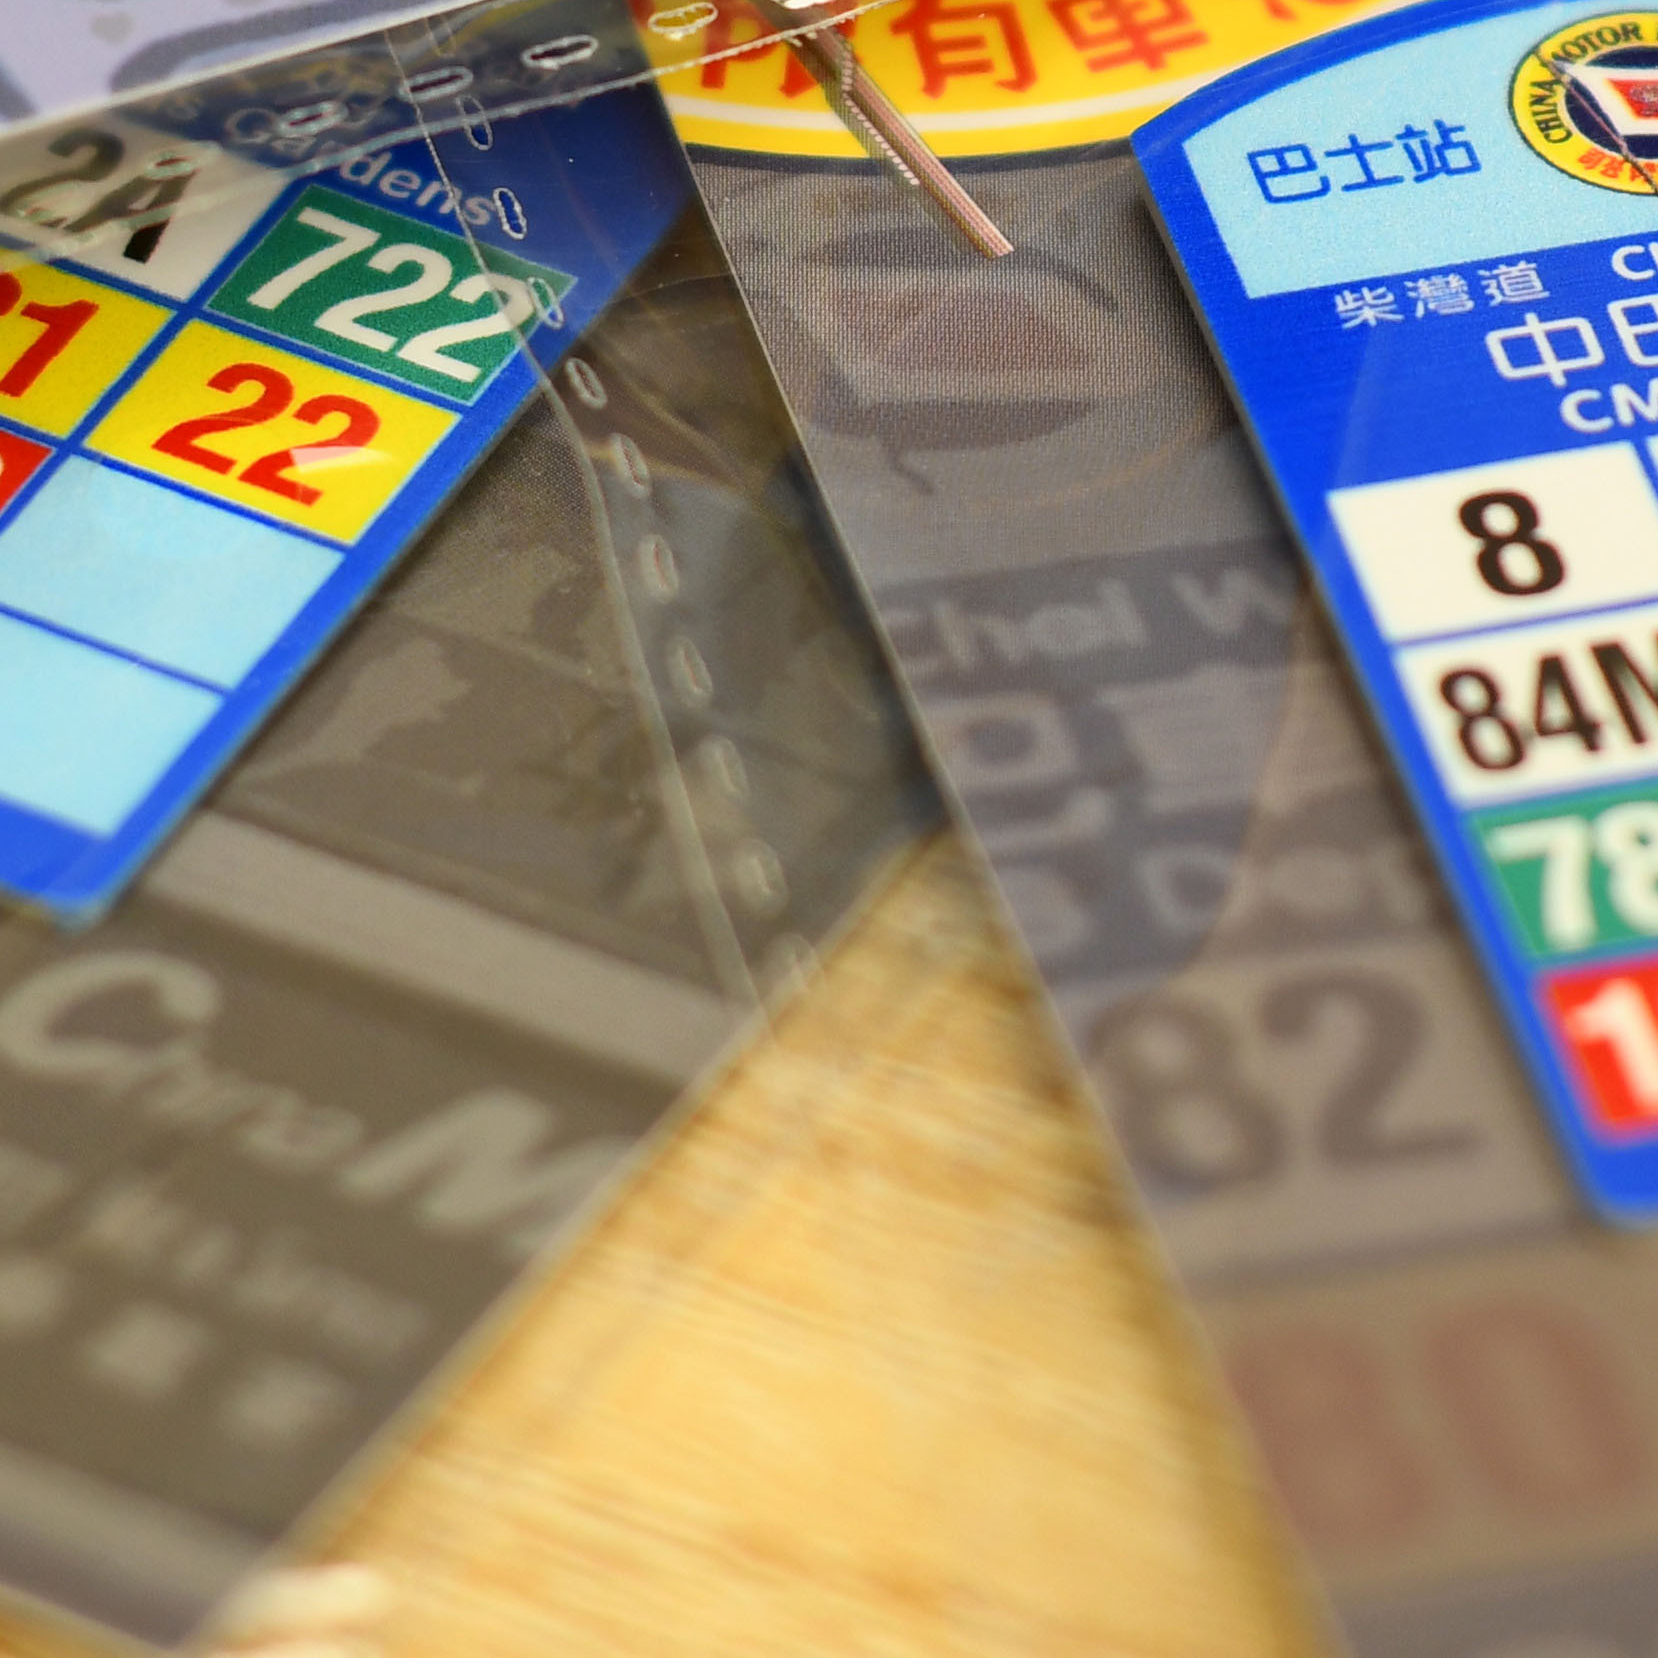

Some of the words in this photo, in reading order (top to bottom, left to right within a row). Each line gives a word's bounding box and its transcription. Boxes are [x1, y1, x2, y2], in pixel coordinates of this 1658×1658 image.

[1530, 77, 1574, 145] CHINA
[1248, 119, 1481, 205] 巴士站
[246, 206, 541, 383] 722
[1333, 261, 1551, 332] 柴灣道
[150, 361, 381, 508] 22
[1456, 488, 1568, 599] 8
